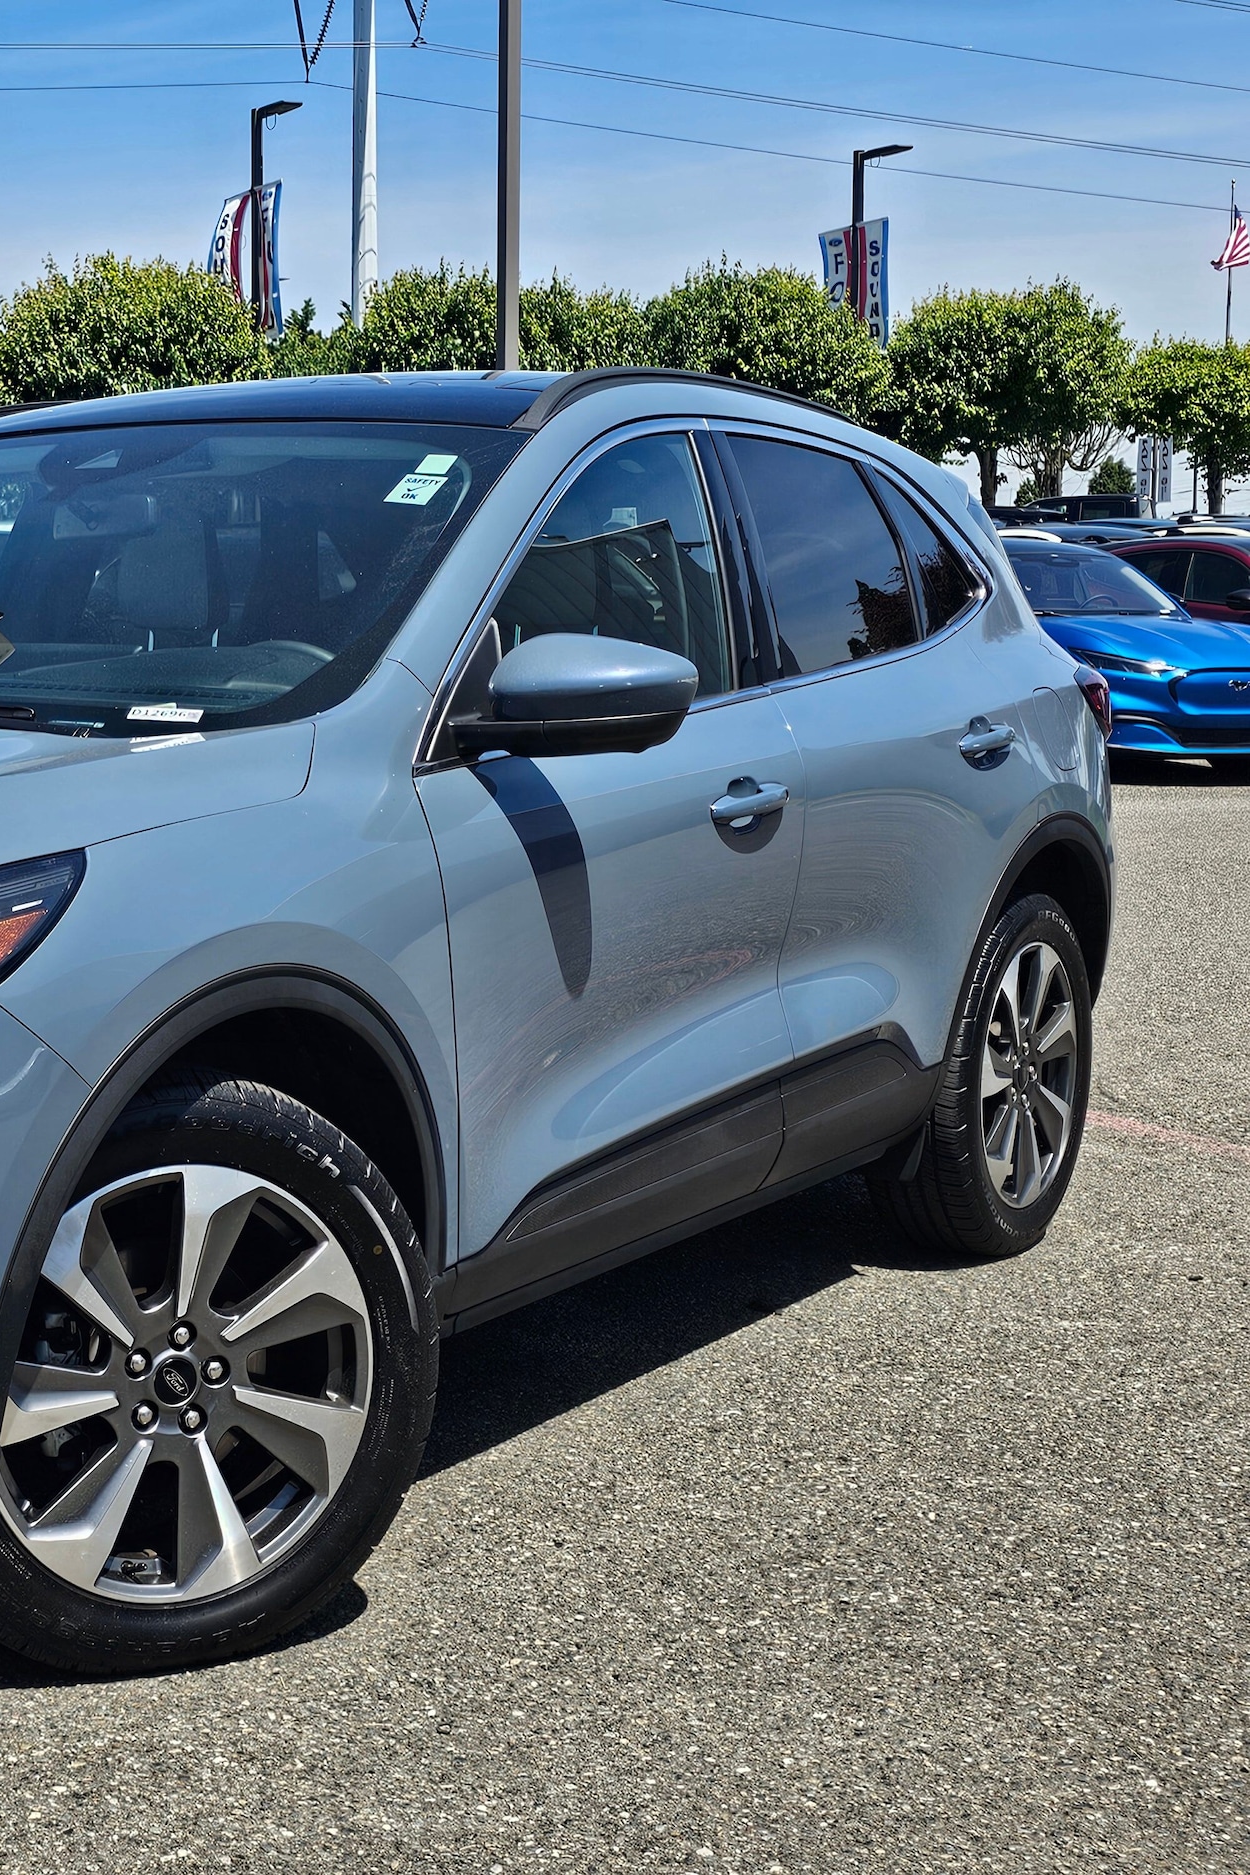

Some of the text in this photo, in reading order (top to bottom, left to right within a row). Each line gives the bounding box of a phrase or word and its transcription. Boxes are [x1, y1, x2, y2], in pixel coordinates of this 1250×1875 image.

[829, 252, 845, 303] FO
[869, 240, 881, 338] SOUND
[405, 477, 441, 486] SAFETY
[166, 1373, 185, 1391] Ford
